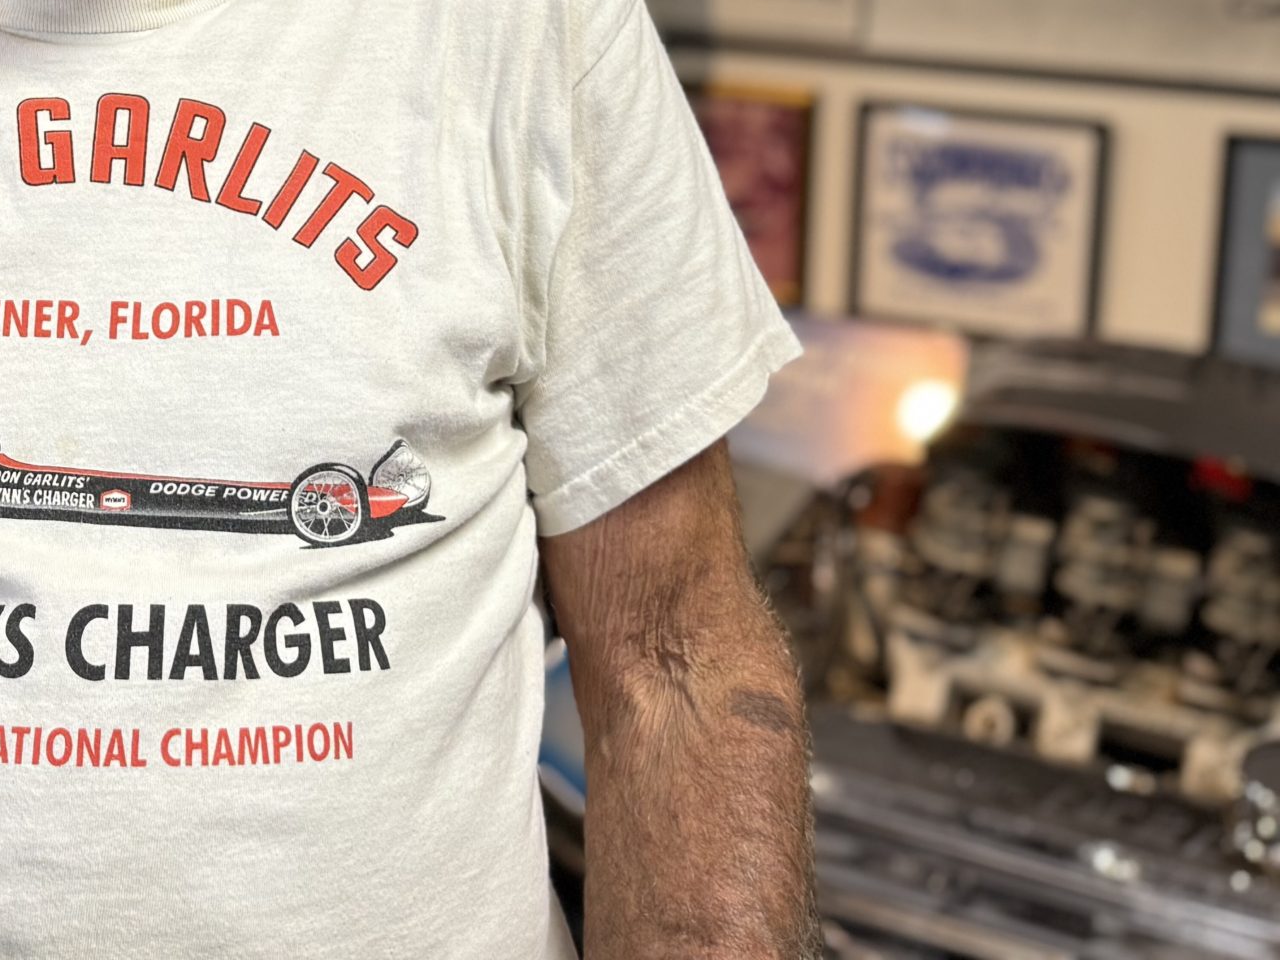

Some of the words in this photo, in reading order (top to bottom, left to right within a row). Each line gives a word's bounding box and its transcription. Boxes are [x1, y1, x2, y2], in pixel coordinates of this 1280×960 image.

[17, 93, 419, 290] GARLITS
[108, 299, 280, 339] FLORIDA
[23, 472, 90, 488] GARLITS'
[33, 489, 95, 508] CHARGER
[150, 482, 219, 497] DODGE
[65, 599, 391, 682] CHARGER
[161, 722, 354, 767] CHAMPION
